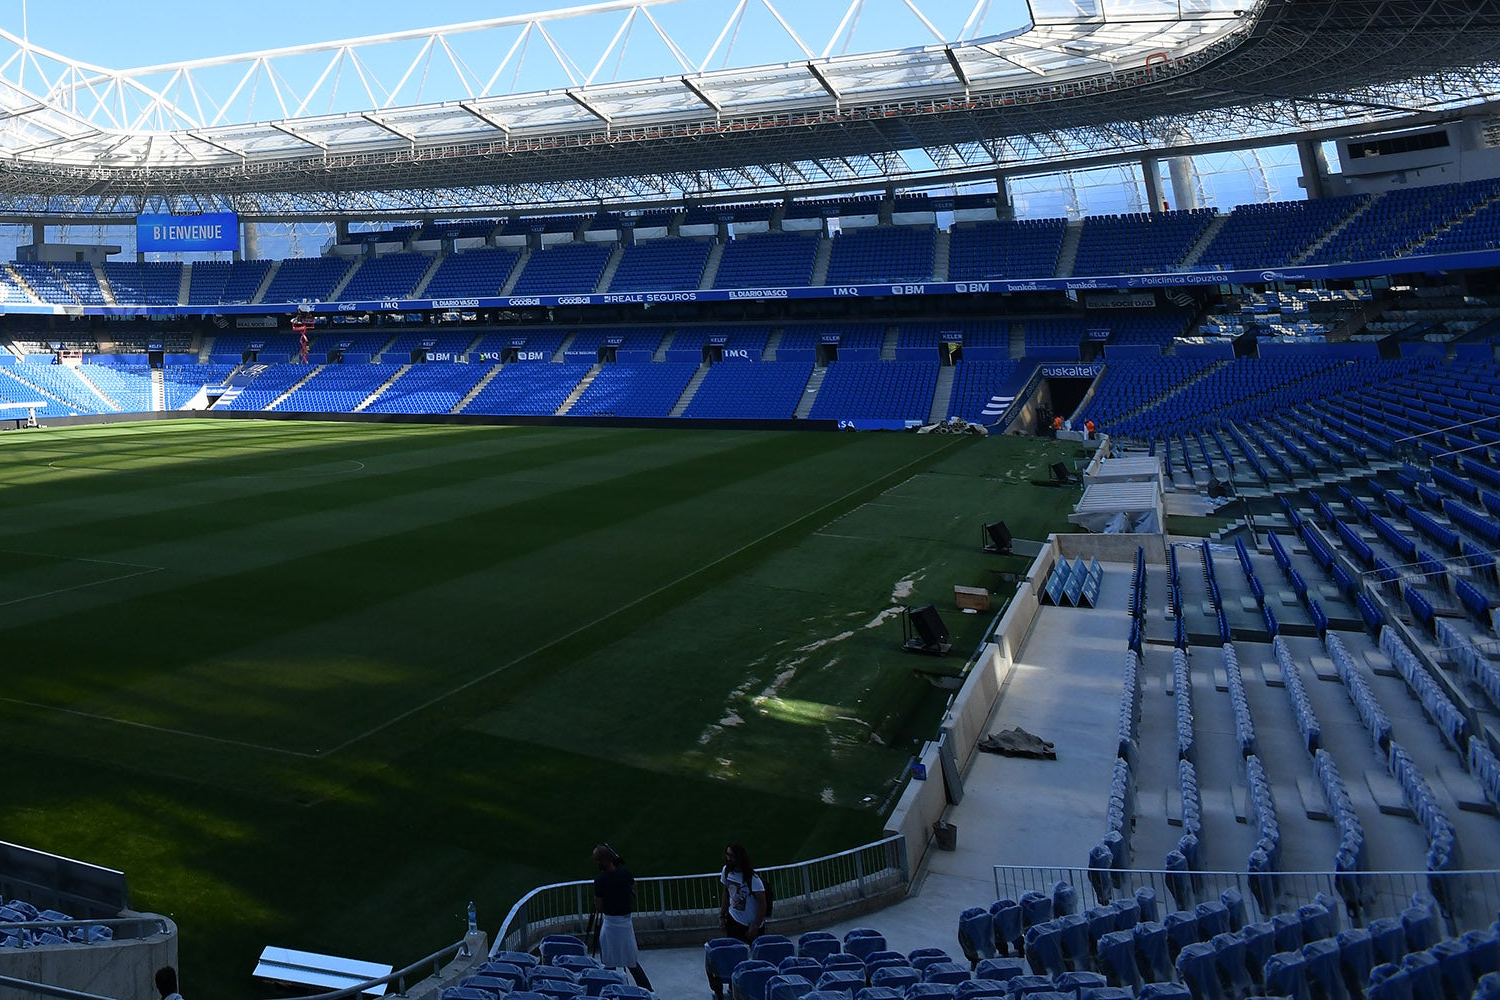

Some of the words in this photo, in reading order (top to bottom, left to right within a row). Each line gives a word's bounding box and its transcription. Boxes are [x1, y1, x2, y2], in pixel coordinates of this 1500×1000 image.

[153, 225, 222, 240] BIENVENUE
[1187, 274, 1228, 284] Gipuzkoa
[905, 286, 924, 294] BM
[969, 283, 989, 292] BM
[833, 288, 859, 296] IMQ
[612, 295, 643, 303] REALE
[647, 293, 697, 302] SEGUROS
[381, 302, 399, 310] IMQ
[528, 352, 543, 360] BM
[725, 350, 748, 358] IMQ
[1042, 366, 1093, 377] euskaltel
